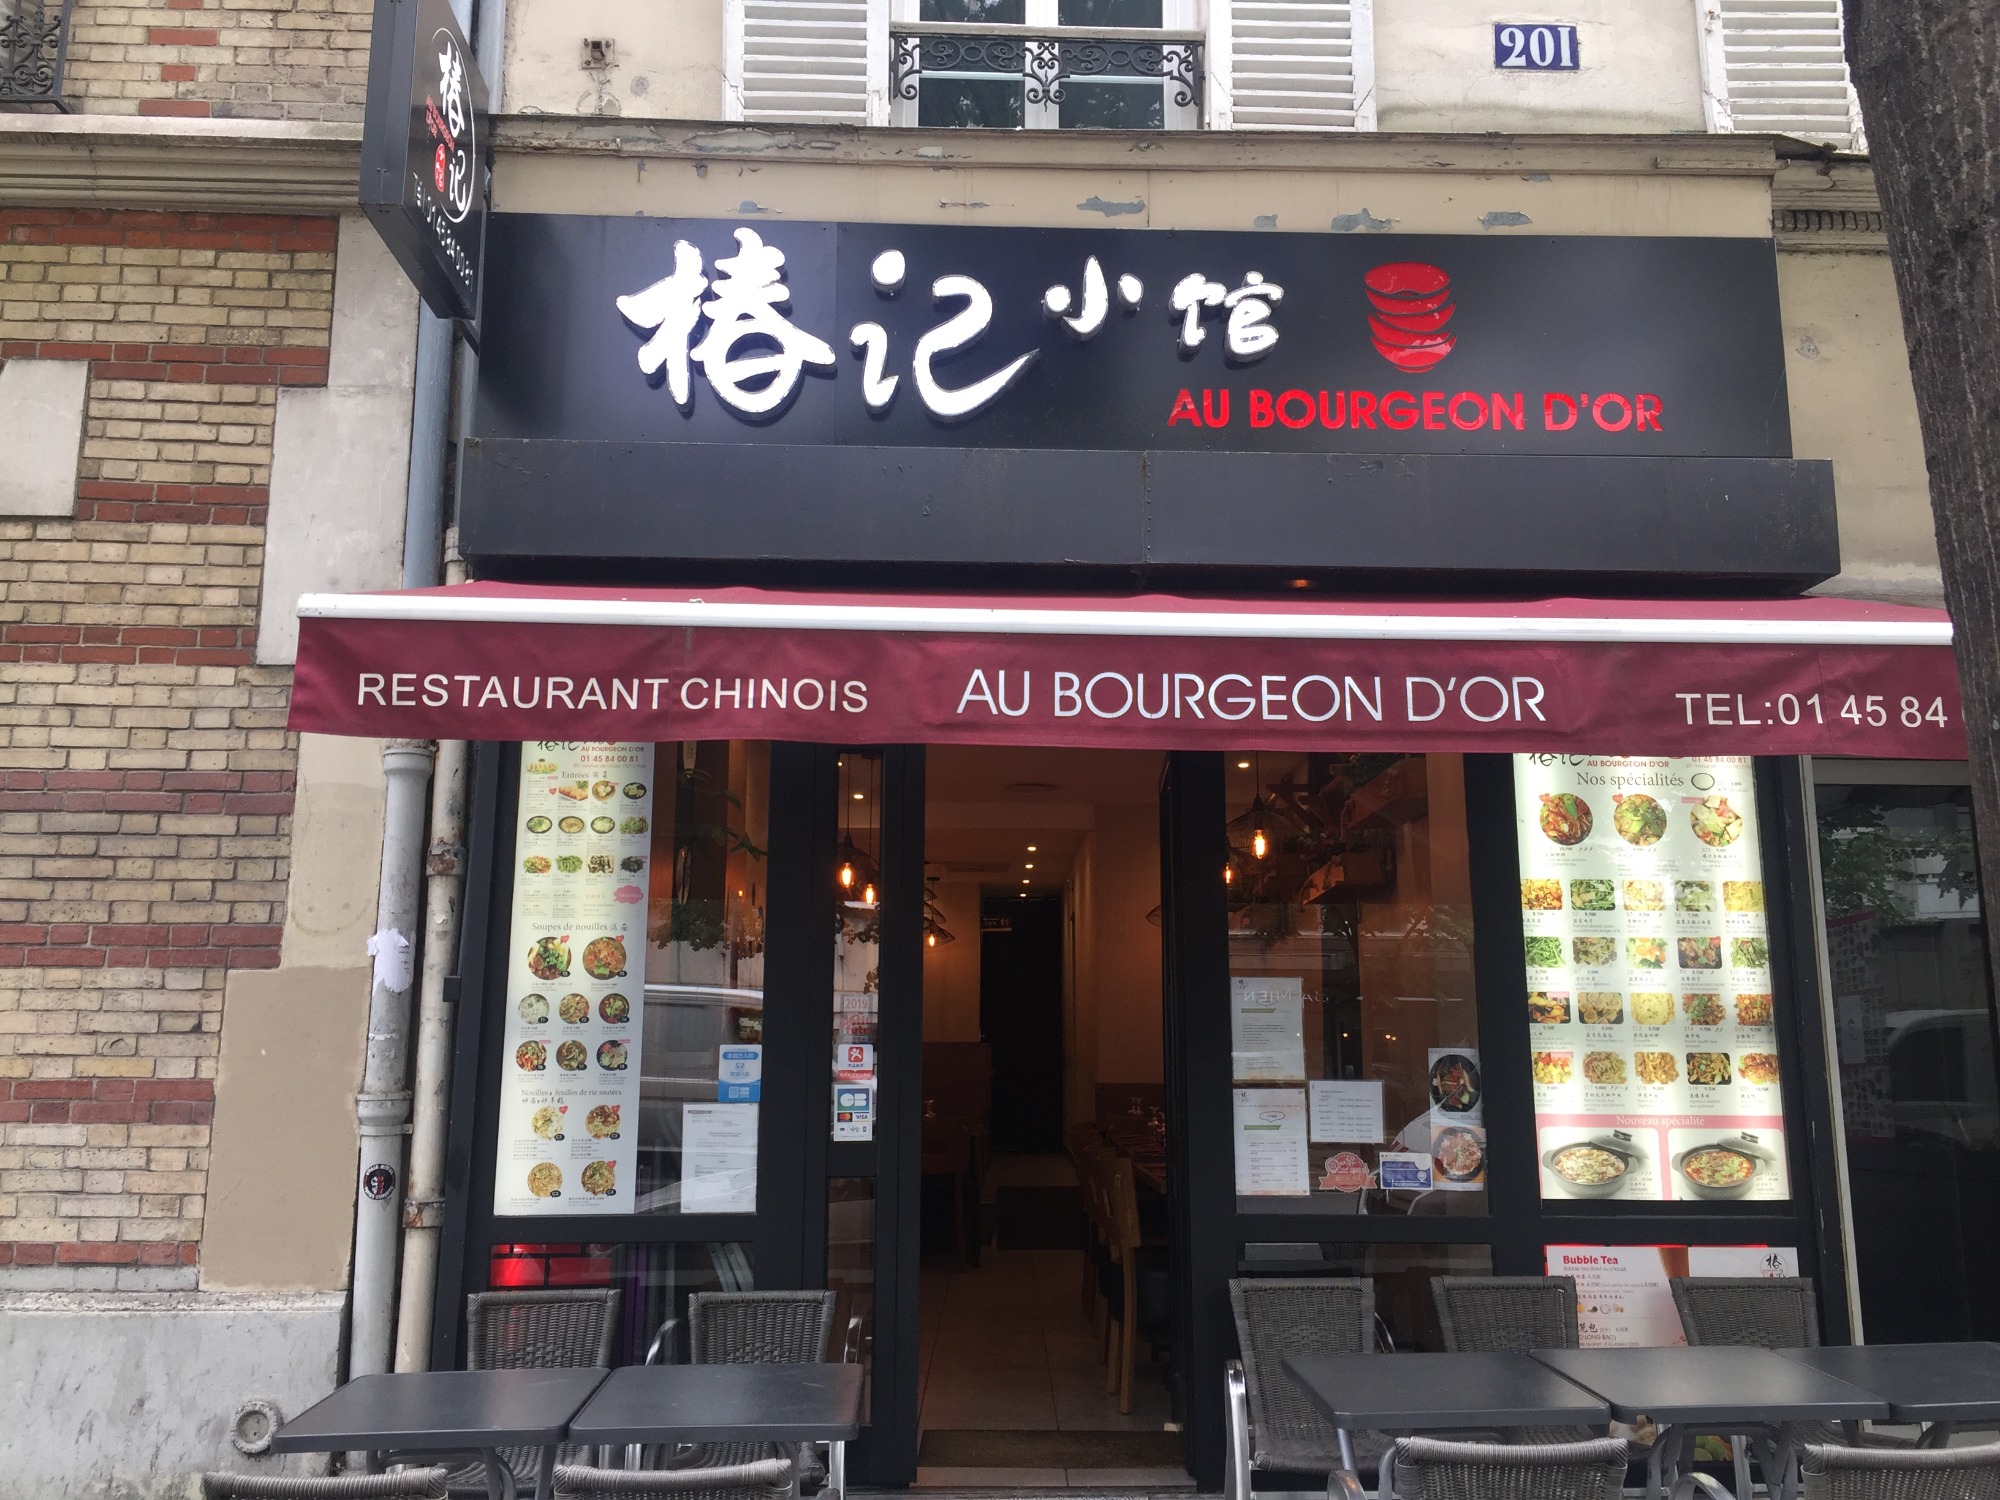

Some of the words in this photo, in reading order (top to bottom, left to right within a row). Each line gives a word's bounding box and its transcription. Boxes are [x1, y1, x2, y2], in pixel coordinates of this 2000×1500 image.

[1500, 27, 1574, 66] 201
[1167, 388, 1230, 428] AU
[1248, 388, 1526, 431] BOURGEON
[1543, 391, 1664, 433] D'OR
[356, 671, 669, 711] RESTAURANT
[680, 676, 869, 714] CHINOIS
[956, 667, 1030, 717] AU
[1053, 670, 1382, 723] BOURGEON
[1406, 674, 1547, 723] D'OR
[1840, 694, 1888, 728] 45
[1899, 695, 1949, 729] 84
[580, 755, 590, 763] 01
[593, 755, 603, 763] 45
[605, 755, 615, 763] 84
[617, 755, 628, 763] 00
[629, 755, 639, 763] 81
[1587, 760, 1598, 768] AU
[1600, 760, 1648, 768] BOURGEON
[1649, 760, 1670, 768] D'OR
[561, 771, 590, 779] Entrées
[1576, 772, 1606, 785] Nos
[1610, 771, 1684, 789] spécialités
[532, 923, 562, 933] Soupes
[563, 922, 573, 931] de
[575, 922, 608, 931] nouilles
[845, 998, 868, 1010] 2019
[1616, 1115, 1659, 1125] Nouveau
[1562, 1255, 1599, 1265] Bubble
[1600, 1255, 1619, 1265] Tea
